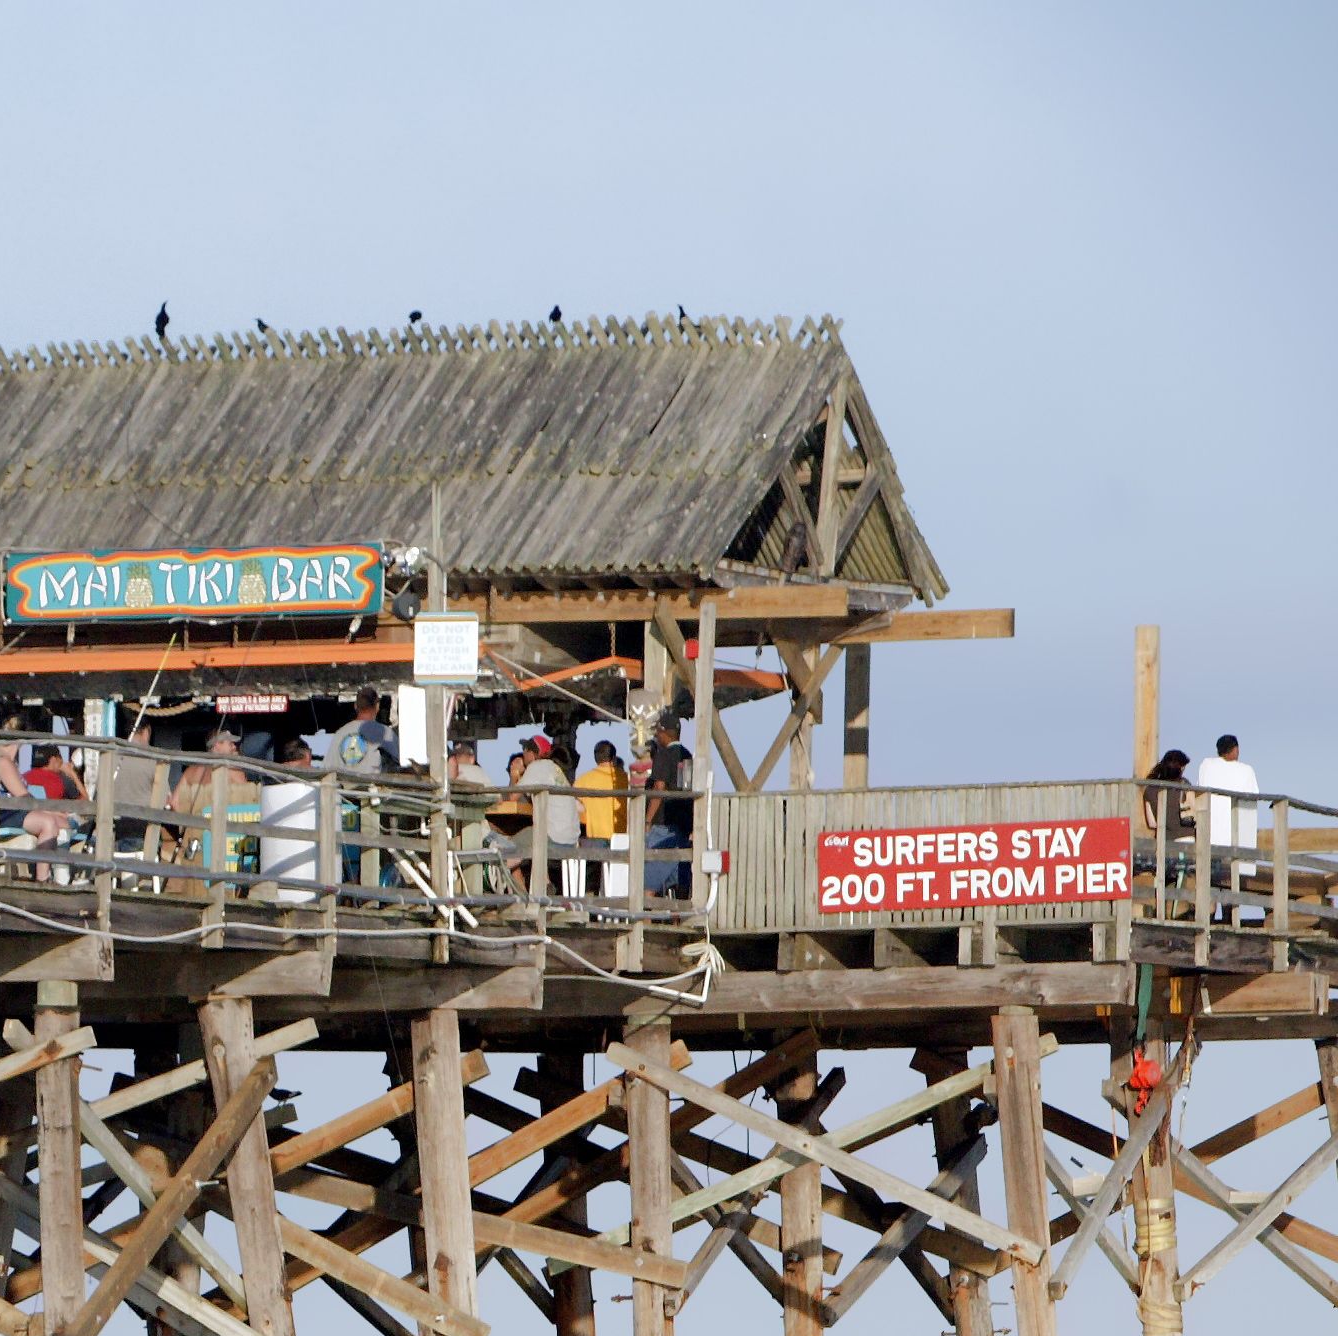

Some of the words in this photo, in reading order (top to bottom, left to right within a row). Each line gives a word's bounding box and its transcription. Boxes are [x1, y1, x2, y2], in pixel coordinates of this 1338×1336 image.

[38, 563, 121, 609] MAI
[157, 561, 235, 605] TIKI
[271, 556, 354, 602] BAR
[423, 625, 440, 634] DO
[445, 624, 470, 634] NOT
[428, 635, 464, 644] FEED
[420, 646, 470, 655] CATFISH
[417, 663, 474, 672] PELICANS
[853, 831, 999, 868] SURFERS
[1011, 826, 1087, 860] STAY
[821, 872, 886, 907] 200
[895, 869, 940, 904] FT.
[950, 863, 1045, 901] FROM
[1055, 862, 1128, 896] PIER
